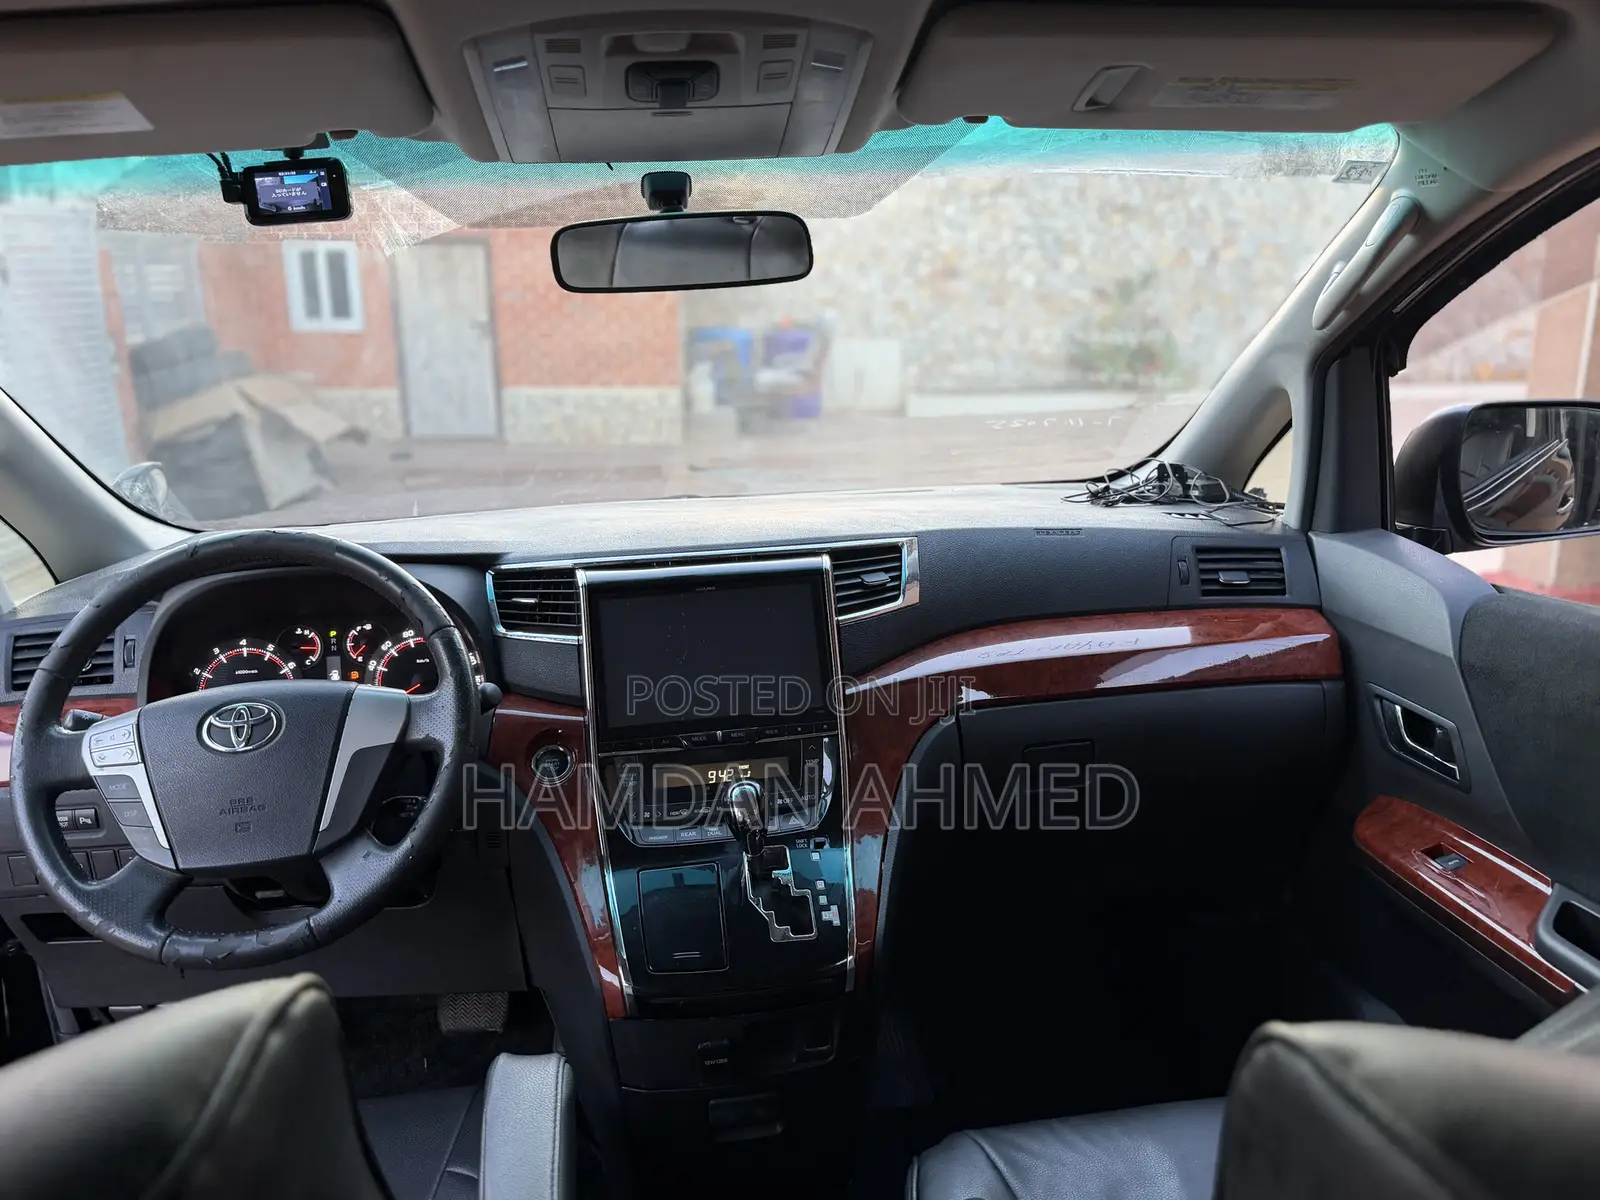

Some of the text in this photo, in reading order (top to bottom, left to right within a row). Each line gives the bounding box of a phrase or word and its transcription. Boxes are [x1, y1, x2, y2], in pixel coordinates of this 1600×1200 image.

[402, 630, 414, 638] 80
[381, 640, 392, 651] 60
[213, 647, 220, 655] 3
[287, 662, 297, 670] 6
[368, 660, 377, 671] 40
[193, 667, 201, 675] 2
[219, 804, 267, 816] AIRBAG
